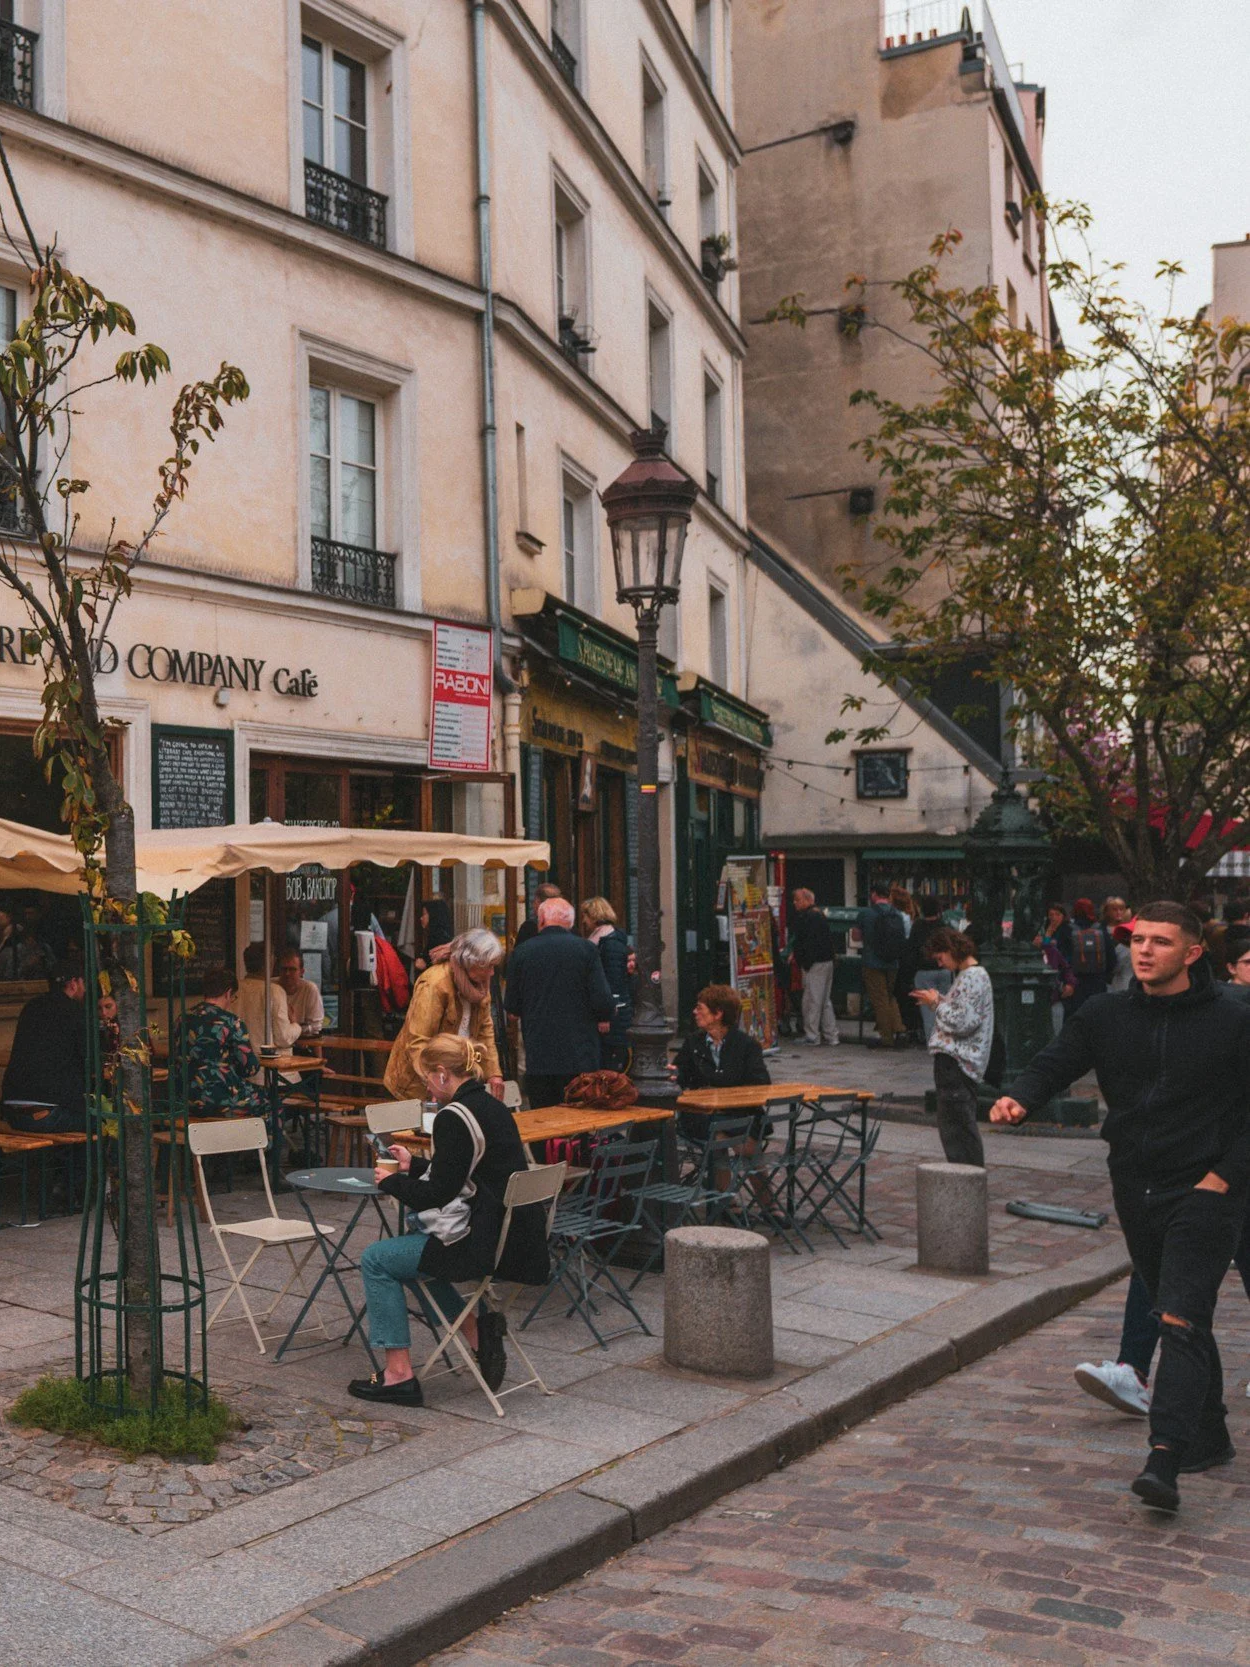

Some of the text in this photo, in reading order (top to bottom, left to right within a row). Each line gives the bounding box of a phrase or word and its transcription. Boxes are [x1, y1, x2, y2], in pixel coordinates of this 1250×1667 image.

[126, 643, 266, 691] COMPANY
[272, 667, 318, 698] Café
[435, 672, 490, 695] RABONI
[172, 741, 188, 749] GOING
